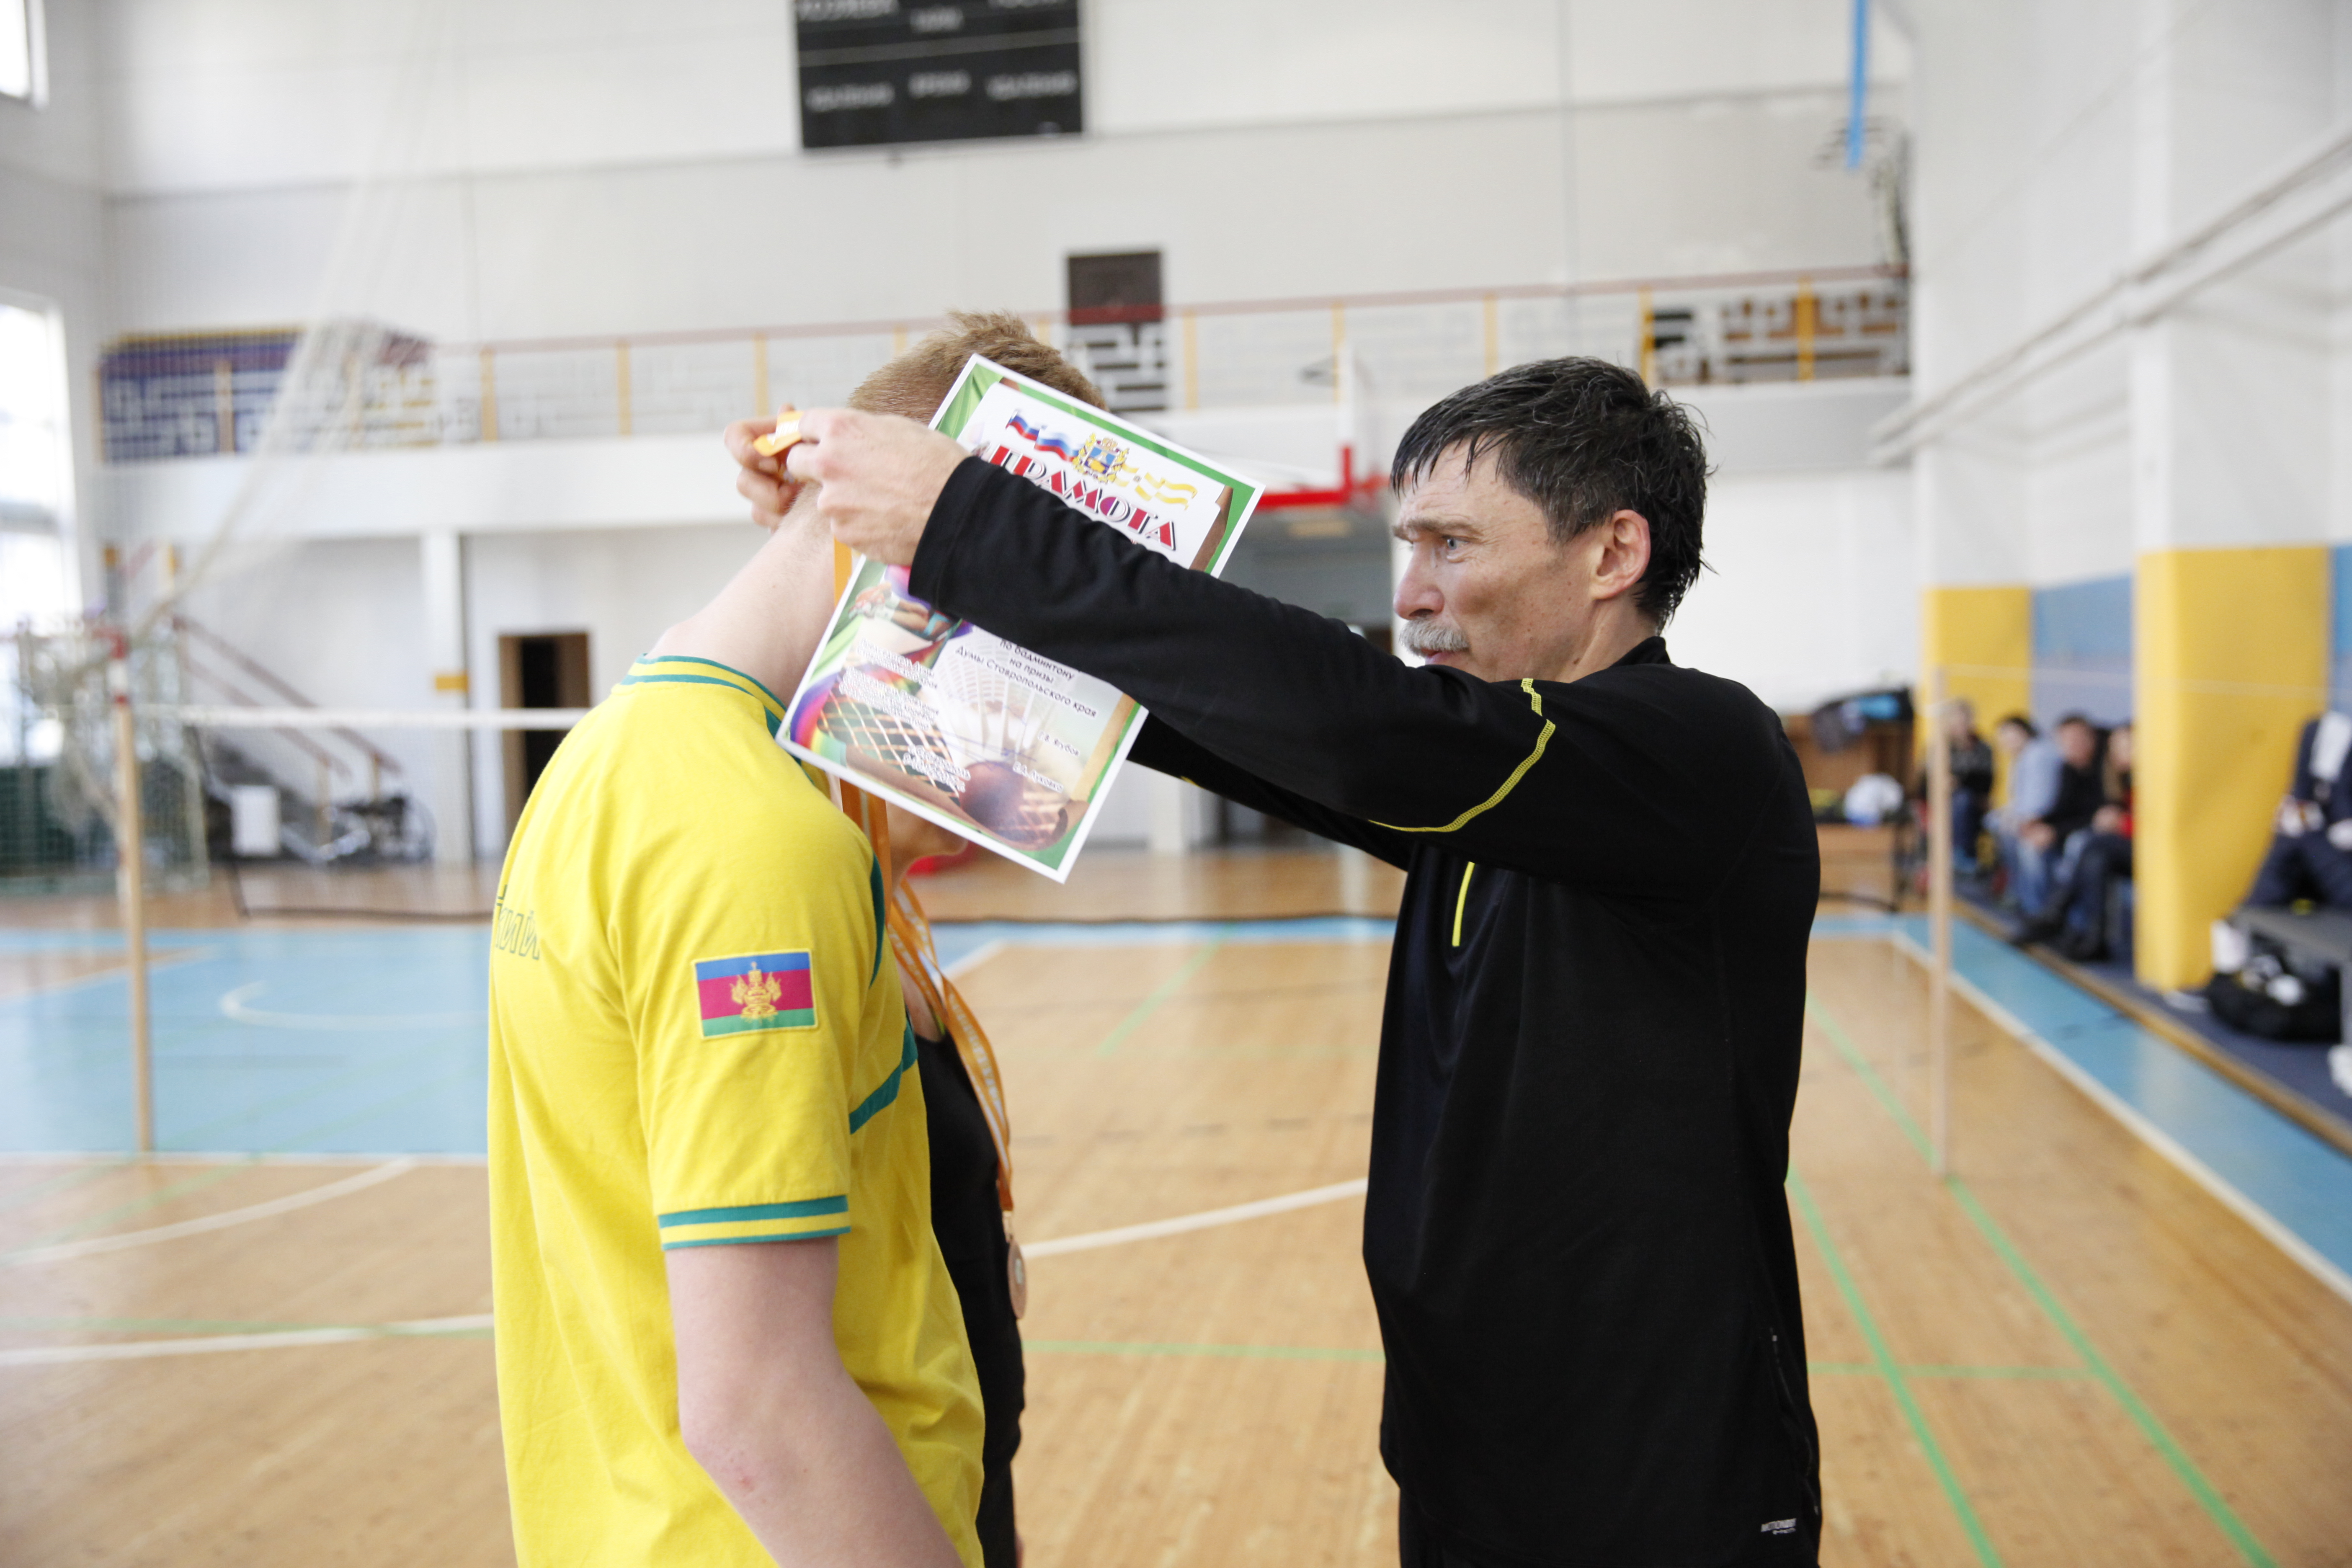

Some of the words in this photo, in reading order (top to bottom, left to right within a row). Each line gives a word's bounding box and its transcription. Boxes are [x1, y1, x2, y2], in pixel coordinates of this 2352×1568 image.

[989, 444, 1176, 551] ГРАМОТА
[955, 646, 984, 665] Думы
[986, 658, 1071, 705] Ставропольского
[1073, 701, 1096, 718] края
[1000, 639, 1012, 650] по
[1014, 645, 1075, 681] бадминтону
[1009, 658, 1022, 668] на
[1024, 664, 1054, 684] призы
